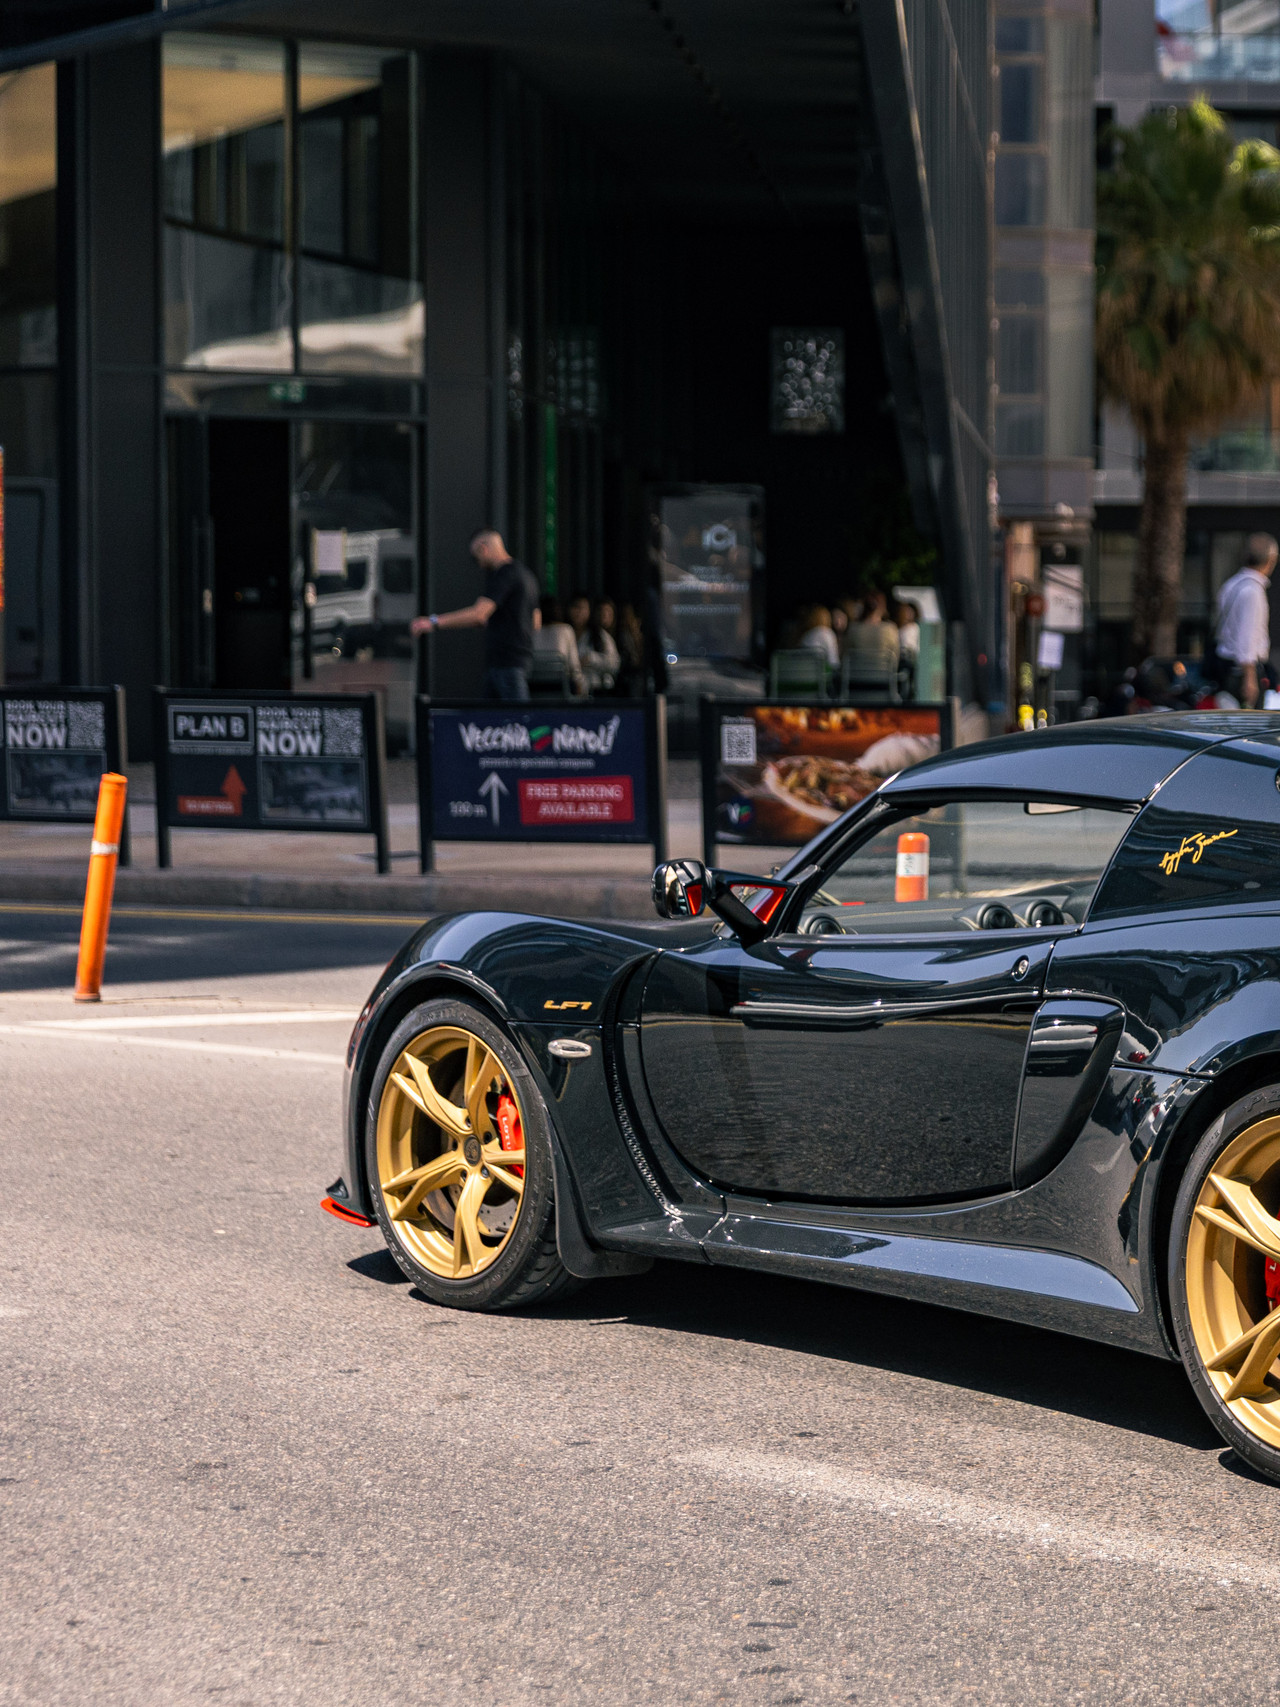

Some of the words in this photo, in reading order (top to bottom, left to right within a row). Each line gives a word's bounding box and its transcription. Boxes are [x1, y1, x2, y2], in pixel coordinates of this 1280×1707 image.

[6, 722, 67, 749] NOW
[176, 714, 227, 738] PLAN
[230, 716, 246, 738] B
[257, 730, 323, 757] NOW
[526, 783, 559, 800] FREE
[562, 783, 624, 800] PARKING
[538, 802, 614, 820] AVAILABLE
[543, 999, 593, 1011] LF1
[502, 1116, 512, 1150] LOTU
